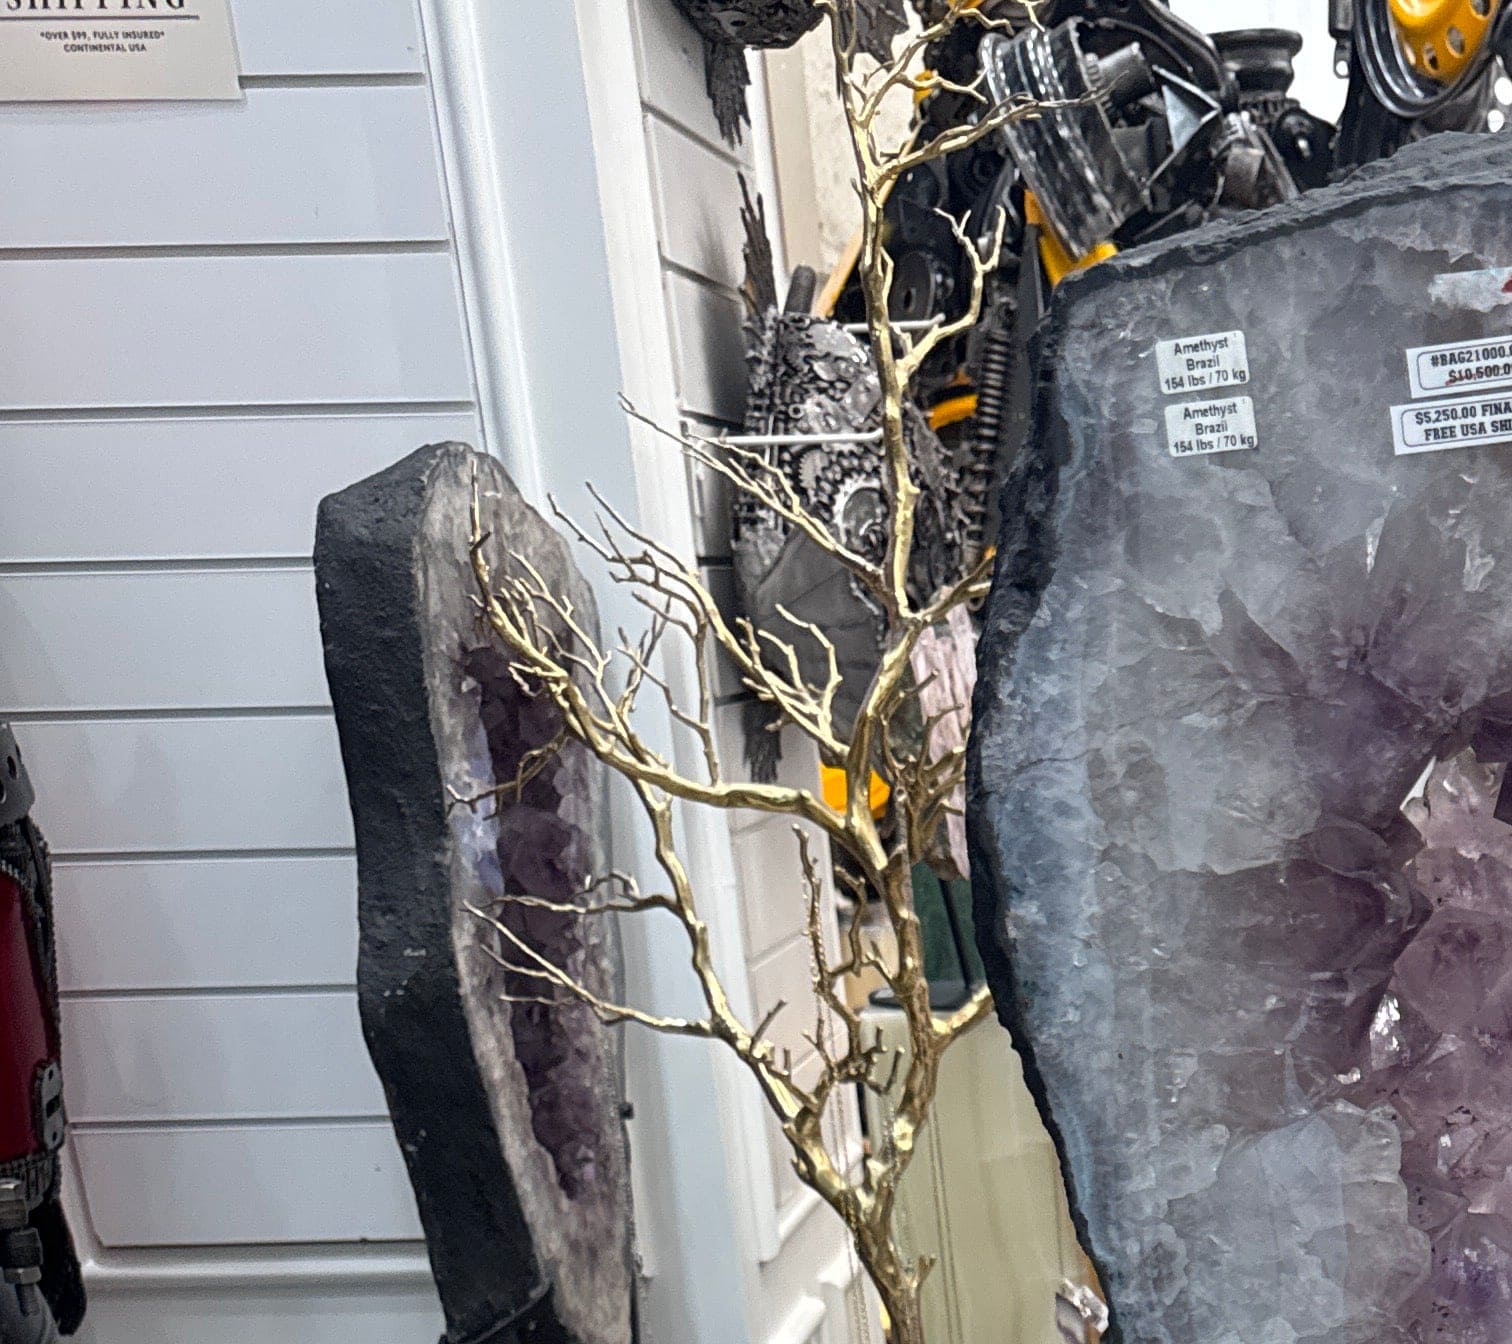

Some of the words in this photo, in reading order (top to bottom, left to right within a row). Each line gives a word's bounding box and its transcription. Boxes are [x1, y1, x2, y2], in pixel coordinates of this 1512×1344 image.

[93, 31, 119, 40] FULLY
[63, 43, 127, 53] CONTINENTAL
[128, 43, 147, 52] USA
[1174, 336, 1229, 356] Amethyst
[1186, 354, 1220, 371] Brazil
[1164, 376, 1185, 391] 154
[1187, 374, 1206, 387] lbs
[1215, 369, 1229, 383] 70
[1231, 368, 1247, 382] kg
[1183, 402, 1237, 421] Amethyst
[1415, 405, 1477, 426] $5,250.00
[1195, 420, 1228, 436] Brazil
[1424, 425, 1457, 442] FREE
[1460, 423, 1487, 437] USA
[1174, 440, 1194, 454] 154
[1196, 439, 1215, 452] lbs
[1223, 434, 1237, 448] 70
[1240, 433, 1255, 448] kg
